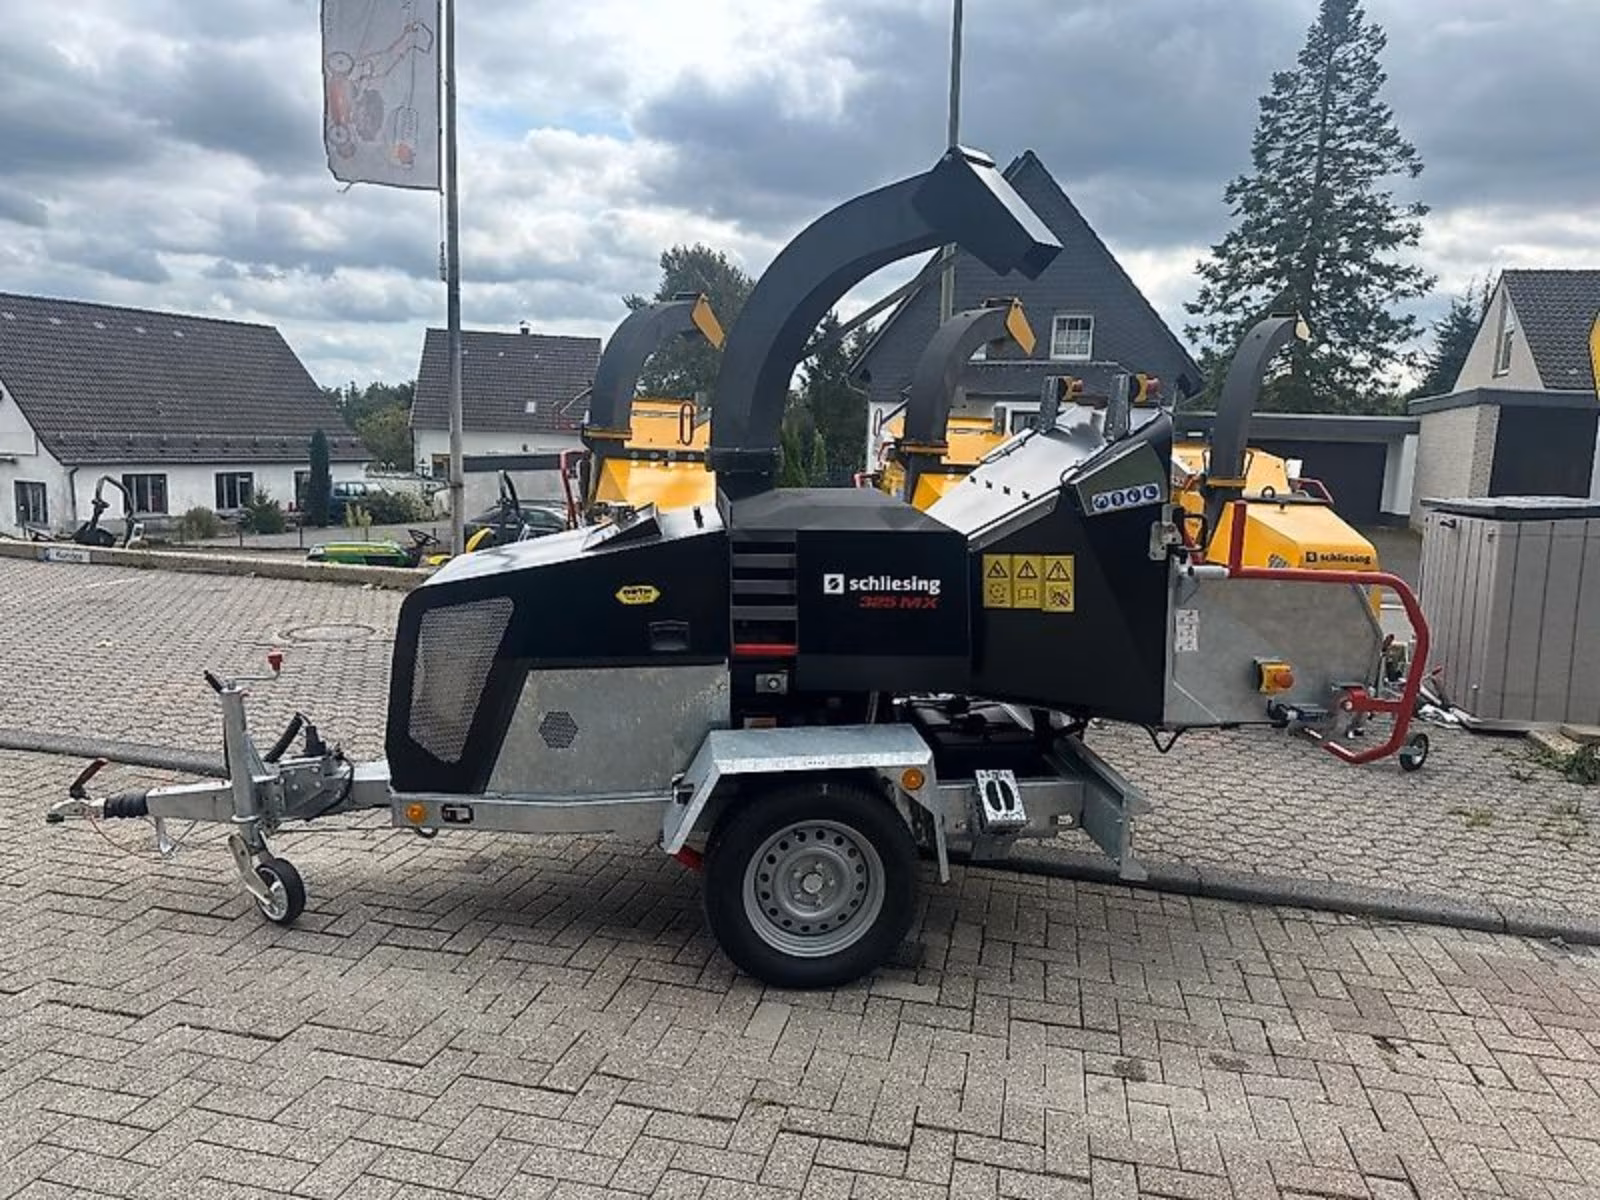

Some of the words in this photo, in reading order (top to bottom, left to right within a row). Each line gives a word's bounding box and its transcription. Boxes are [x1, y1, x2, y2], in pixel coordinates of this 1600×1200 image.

[1320, 553, 1371, 565] schliesing
[849, 575, 941, 595] schliesing
[900, 595, 939, 609] MX
